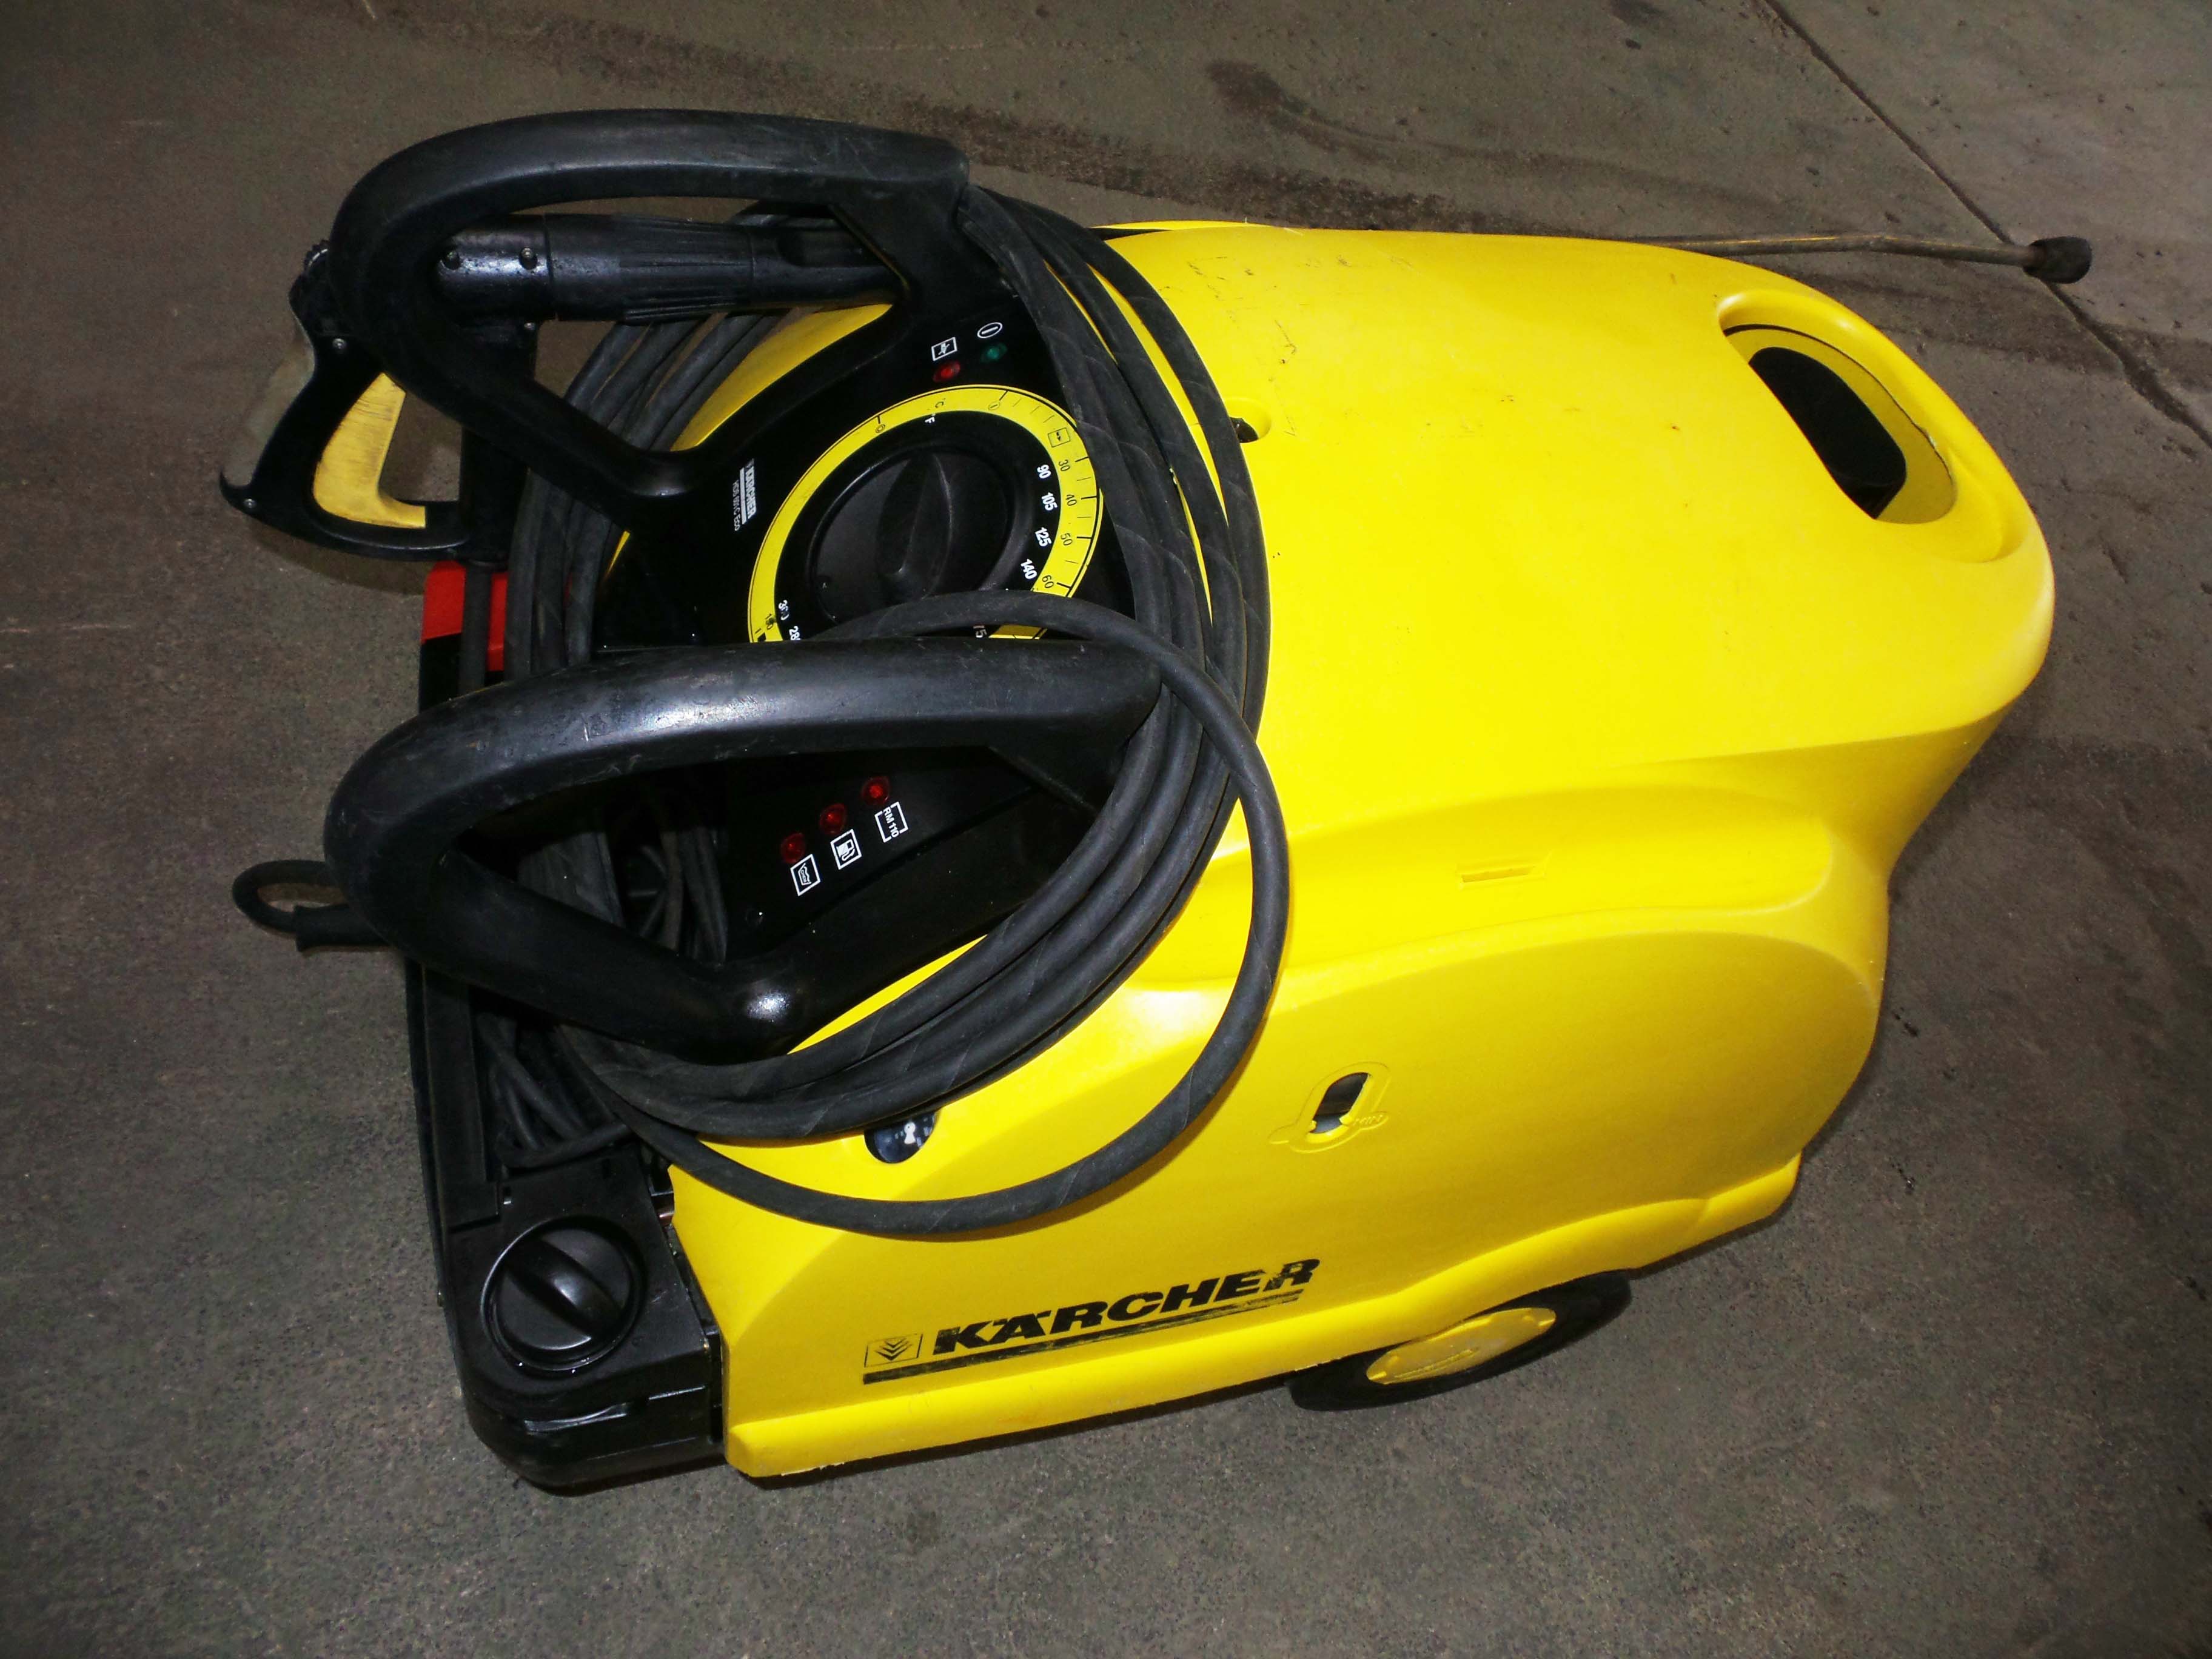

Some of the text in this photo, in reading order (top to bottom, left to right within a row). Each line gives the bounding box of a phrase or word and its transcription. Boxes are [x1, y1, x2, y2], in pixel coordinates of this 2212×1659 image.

[1036, 464, 1051, 479] 90
[1058, 459, 1070, 472] 30
[1041, 492, 1058, 511] 105
[1065, 494, 1078, 506] 40
[1034, 527, 1052, 547] 125
[1061, 532, 1073, 546] 50
[1020, 558, 1037, 580] 140
[1042, 575, 1054, 589] 60
[883, 806, 899, 837] RM 110
[933, 1258, 1321, 1355] KÄRCHER
